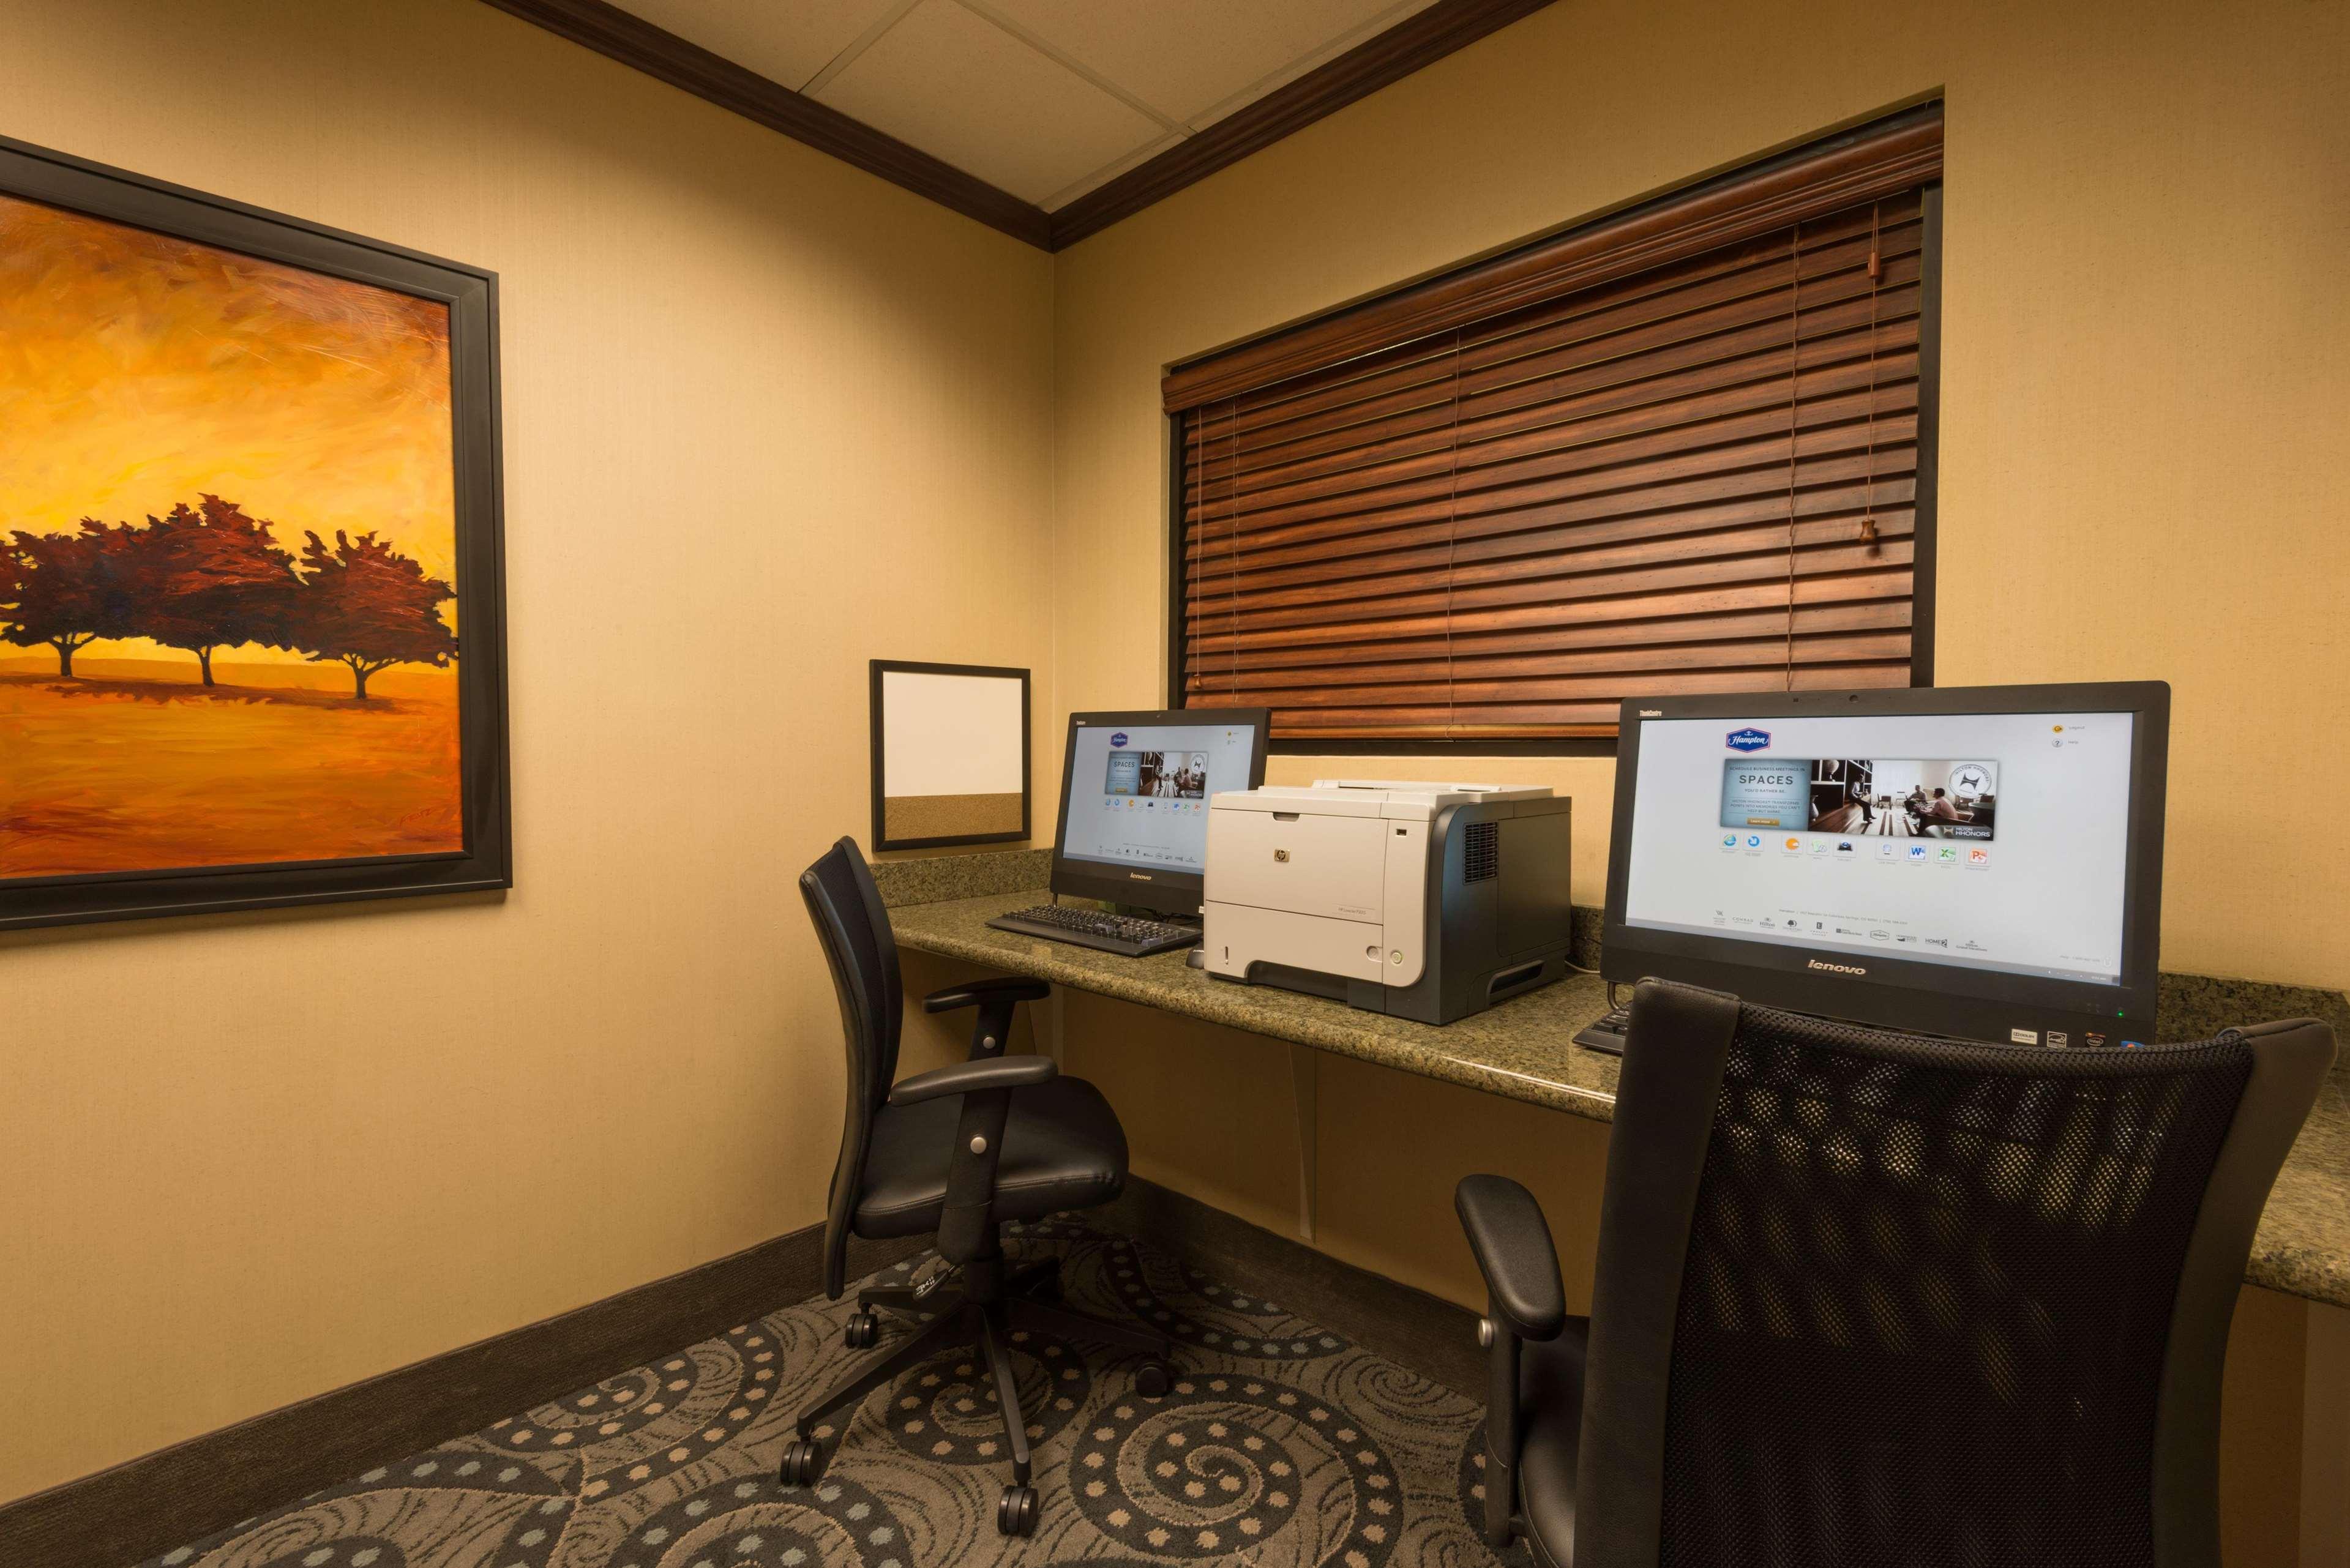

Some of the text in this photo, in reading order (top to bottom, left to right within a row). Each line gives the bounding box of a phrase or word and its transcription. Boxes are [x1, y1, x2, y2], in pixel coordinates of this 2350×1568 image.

[1728, 736, 1768, 745] Hampton
[1739, 775, 1794, 785] SPACES
[1130, 872, 1152, 881] lenovo
[1808, 960, 1866, 975] lenovo
